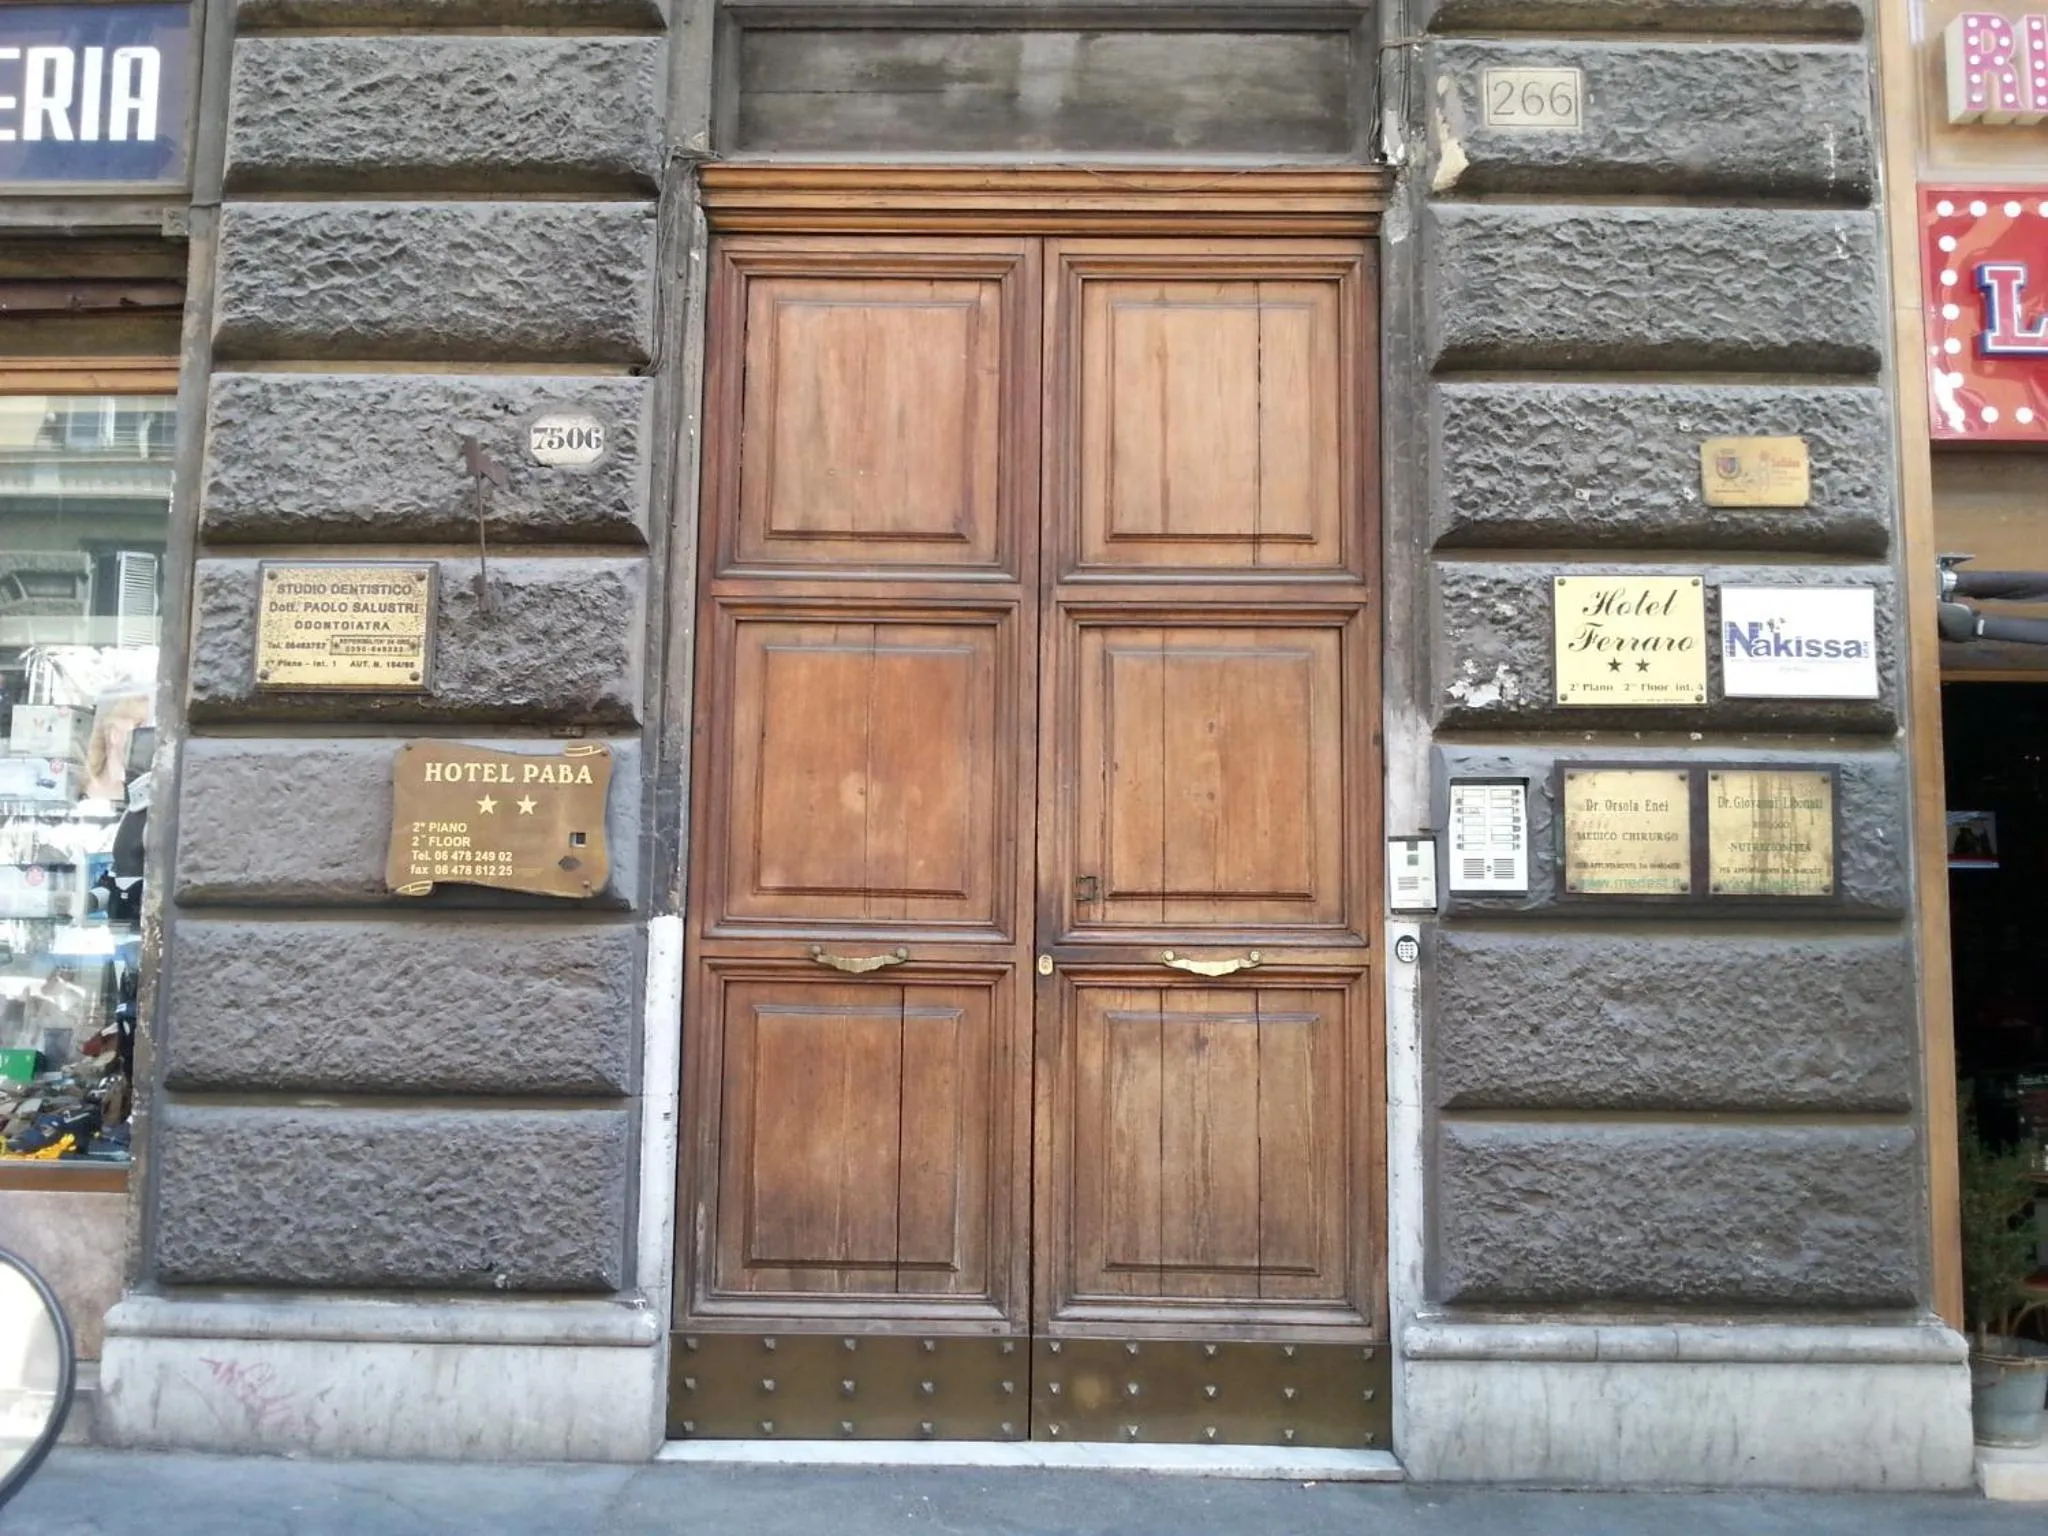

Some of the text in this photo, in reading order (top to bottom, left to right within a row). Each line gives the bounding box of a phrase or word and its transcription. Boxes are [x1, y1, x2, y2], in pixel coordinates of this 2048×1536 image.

[1493, 80, 1572, 116] 266
[532, 426, 602, 450] 7506
[277, 583, 413, 596] STUDIO DENTISTICO
[268, 601, 419, 613] Dott. PAOLO SALUSTRI
[1582, 587, 1678, 616] Hotel
[294, 620, 390, 631] ODONTOIATRA
[1568, 622, 1697, 652] Ferraro
[1725, 621, 1862, 658] Nakissa
[1582, 683, 1614, 692] Piano
[424, 762, 594, 784] HOTEL PABA
[1604, 799, 1639, 812] Orsola
[428, 821, 468, 833] PIANO
[428, 836, 471, 847] FLOOR
[1576, 831, 1679, 841] MEDICO CHIRURGO
[434, 850, 449, 861] 06
[451, 850, 472, 861] 478
[475, 850, 496, 862] 249
[498, 851, 513, 862] 02
[410, 864, 429, 875] fax
[434, 864, 449, 875] 06
[451, 864, 473, 876] 478
[498, 865, 513, 876] 25
